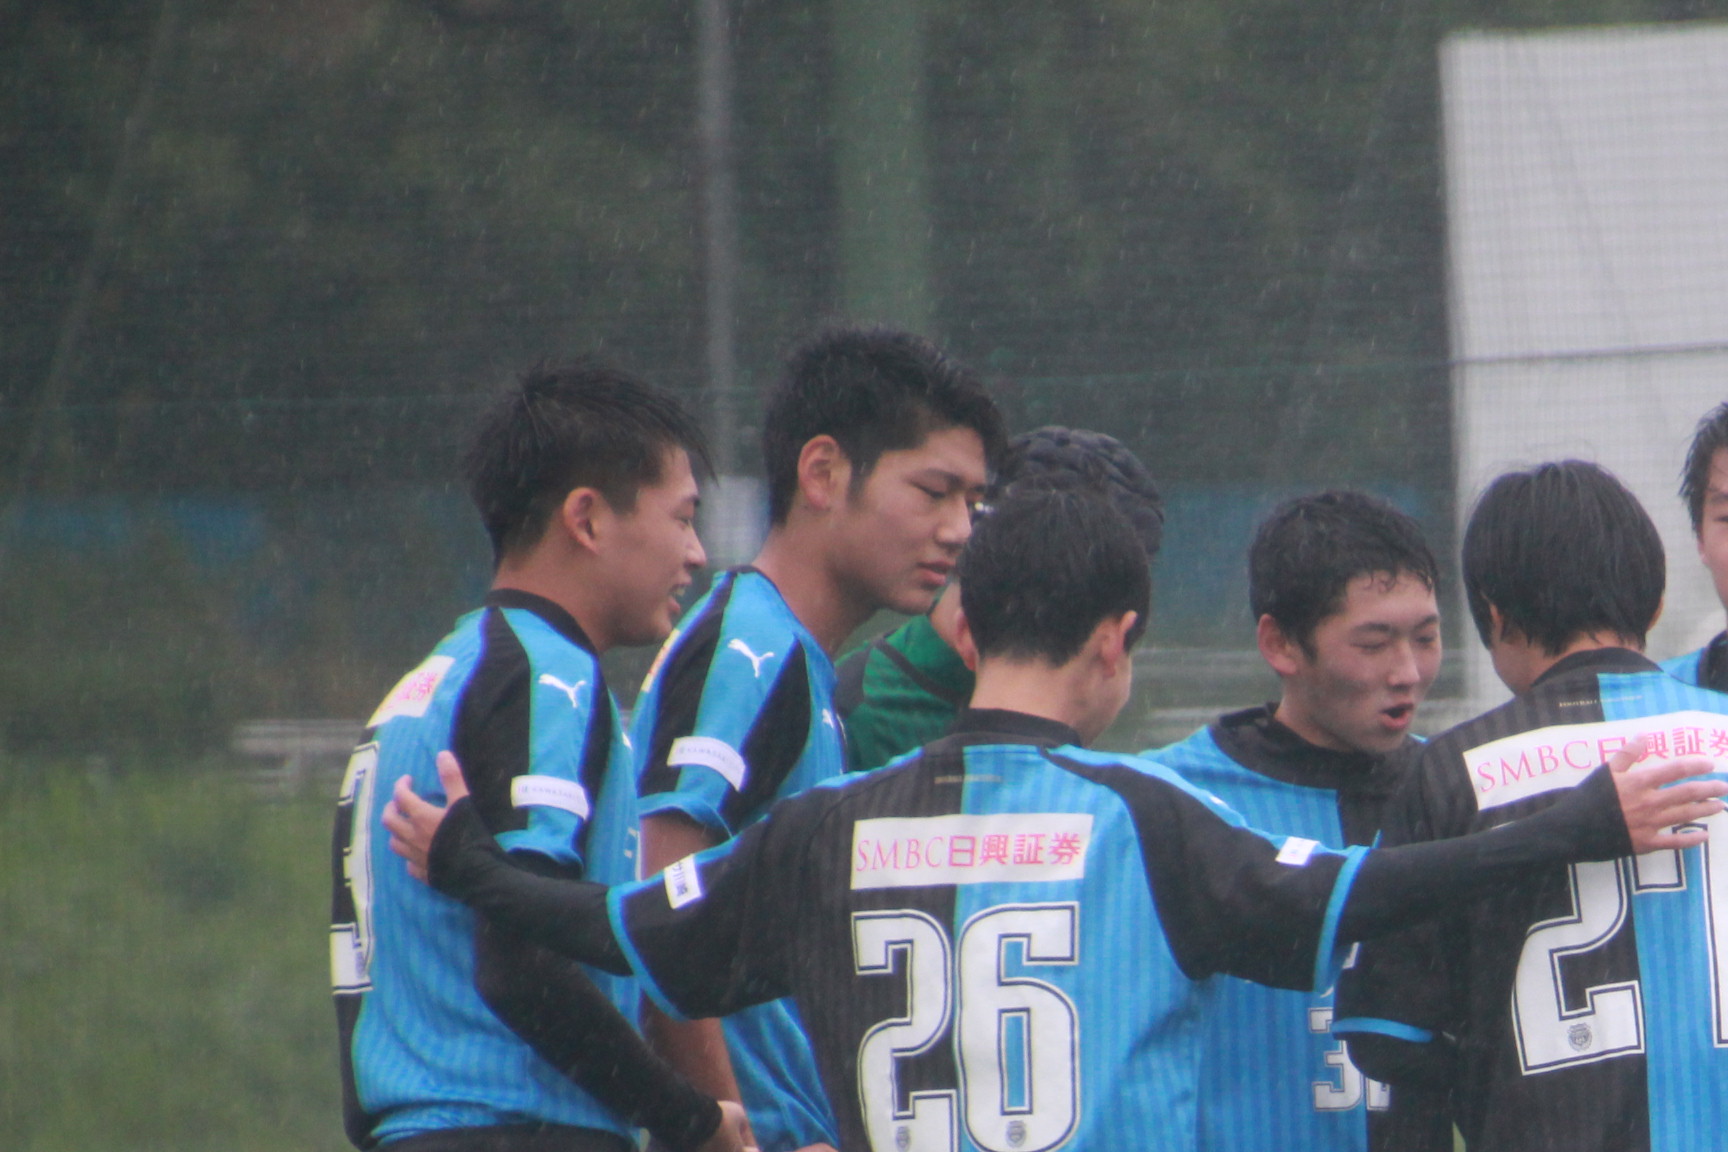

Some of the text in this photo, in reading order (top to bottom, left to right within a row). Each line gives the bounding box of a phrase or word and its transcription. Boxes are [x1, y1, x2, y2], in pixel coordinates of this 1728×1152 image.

[856, 832, 1082, 872] SMBC日興証券
[1307, 1006, 1390, 1112] 3
